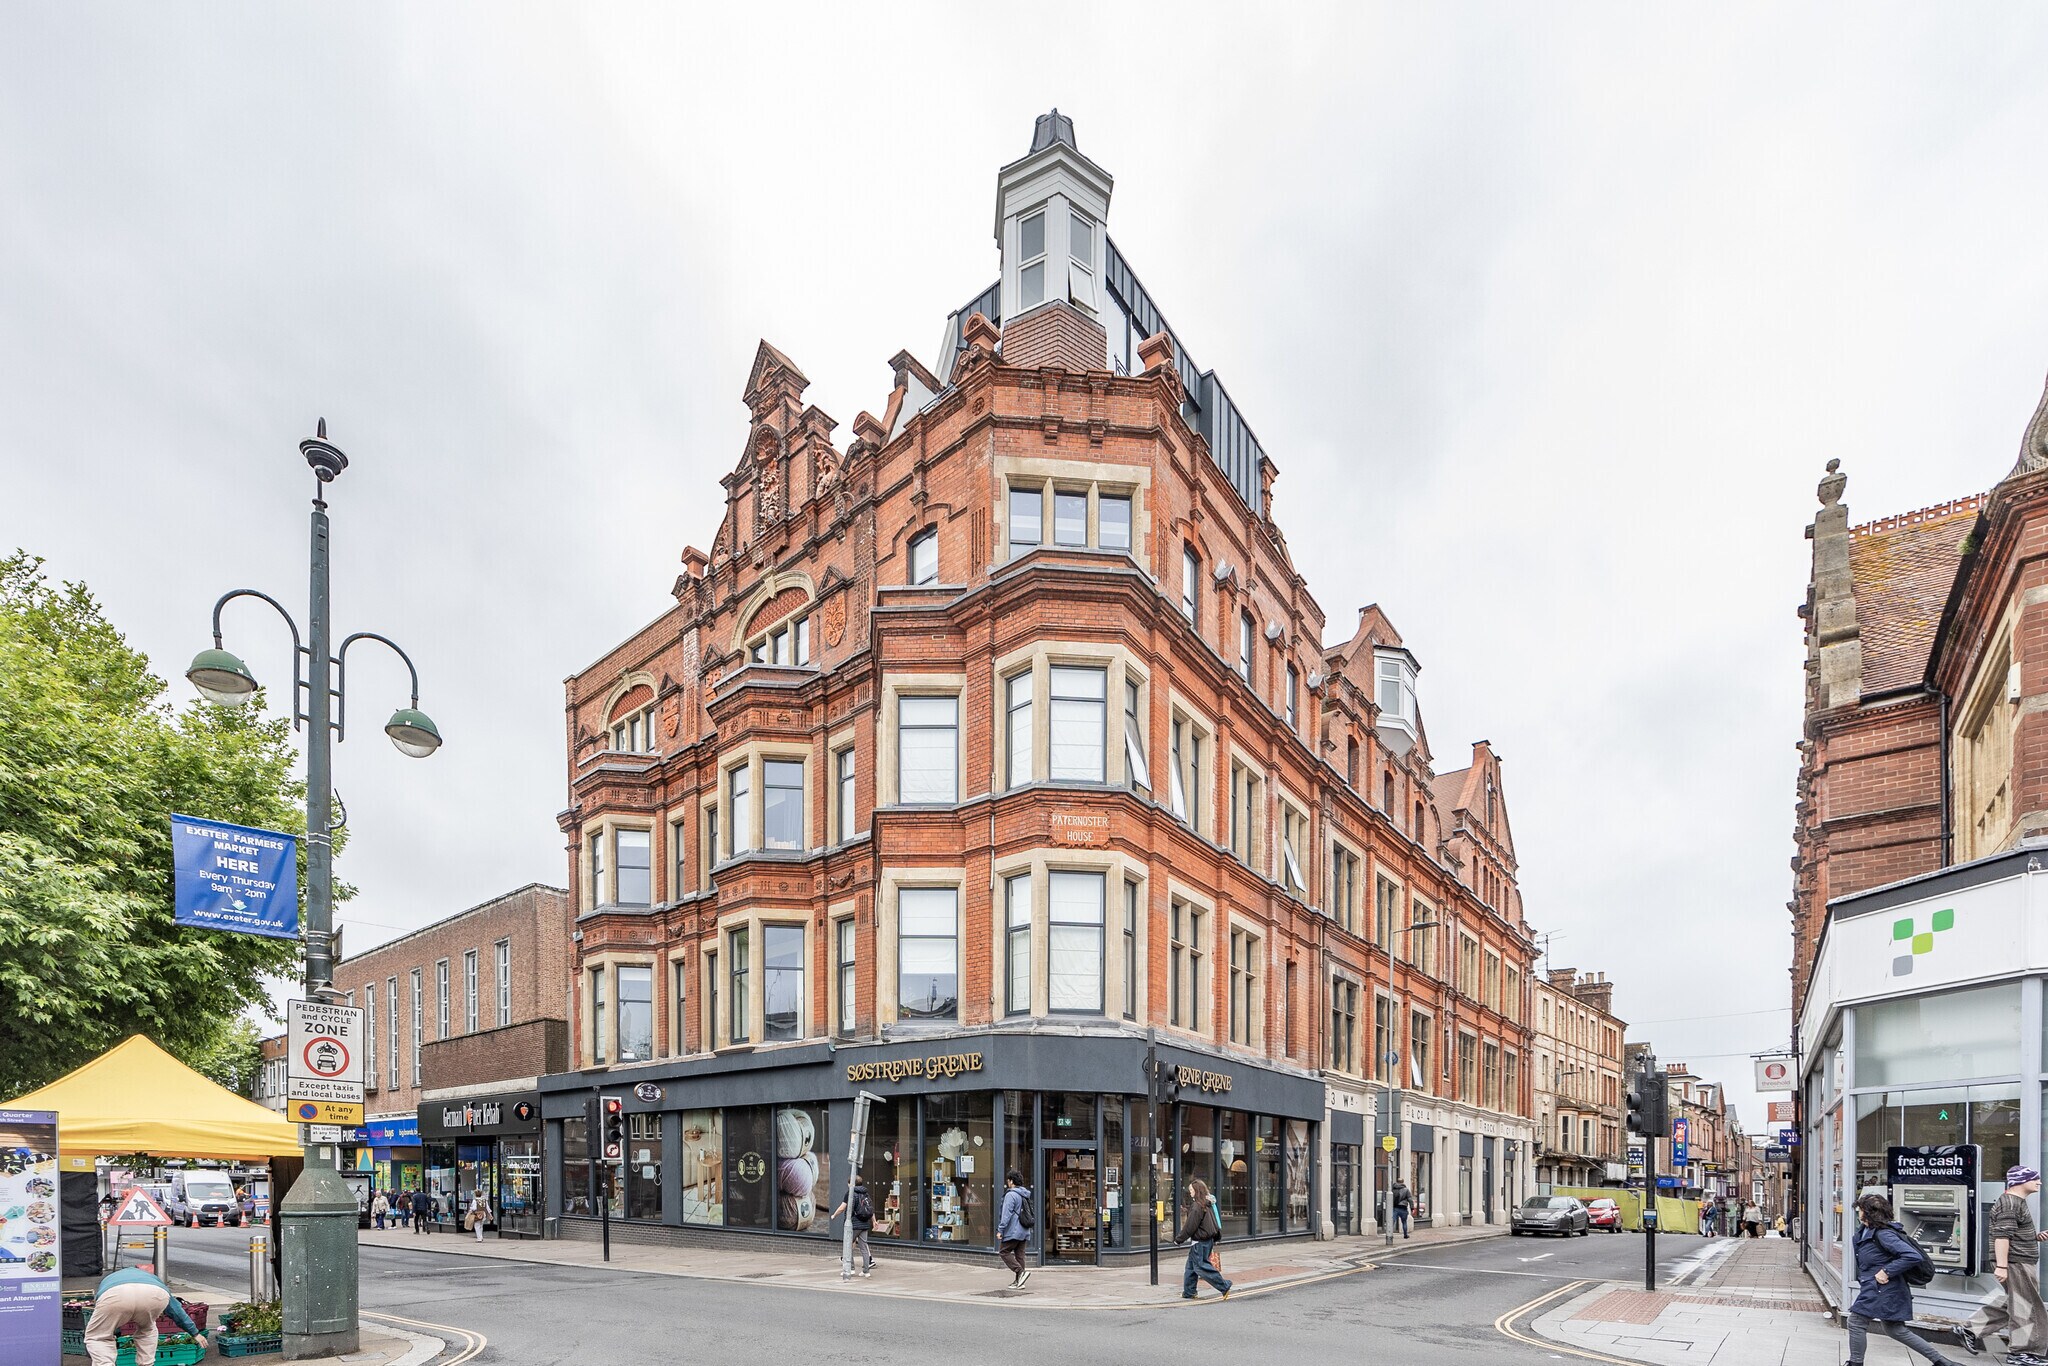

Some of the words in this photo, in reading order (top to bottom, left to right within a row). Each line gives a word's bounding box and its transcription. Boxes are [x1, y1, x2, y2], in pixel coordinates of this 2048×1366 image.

[1052, 814, 1108, 827] PATERNOSTER
[186, 826, 229, 840] EXETER
[234, 834, 284, 850] FARMERS
[1067, 830, 1094, 842] HOUSE
[214, 841, 259, 856] MARKET
[216, 856, 259, 874] HERE
[199, 870, 228, 884] Every
[231, 875, 276, 891] Thursday
[211, 882, 232, 894] 9am
[244, 888, 266, 899] 2pm
[193, 909, 284, 928] www.exeter.gov.uk
[296, 1003, 357, 1017] PEDESTRIAN
[320, 1015, 352, 1024] CYCLE
[304, 1022, 348, 1036] ZONE
[847, 1058, 924, 1082] SØSTRENE
[925, 1052, 984, 1080] GRENE
[1178, 1065, 1202, 1088] RENE
[1202, 1070, 1232, 1094] GRENE
[299, 1082, 330, 1091] Except
[332, 1084, 354, 1092] taxis
[311, 1090, 332, 1098] local
[336, 1092, 360, 1100] buses
[329, 1112, 349, 1120] time
[442, 1106, 463, 1128] German
[482, 1102, 500, 1126] Kebab
[342, 1130, 358, 1142] PURE
[1897, 1154, 1925, 1167] free
[1928, 1154, 1963, 1166] cash
[1897, 1166, 1962, 1176] withdrawals
